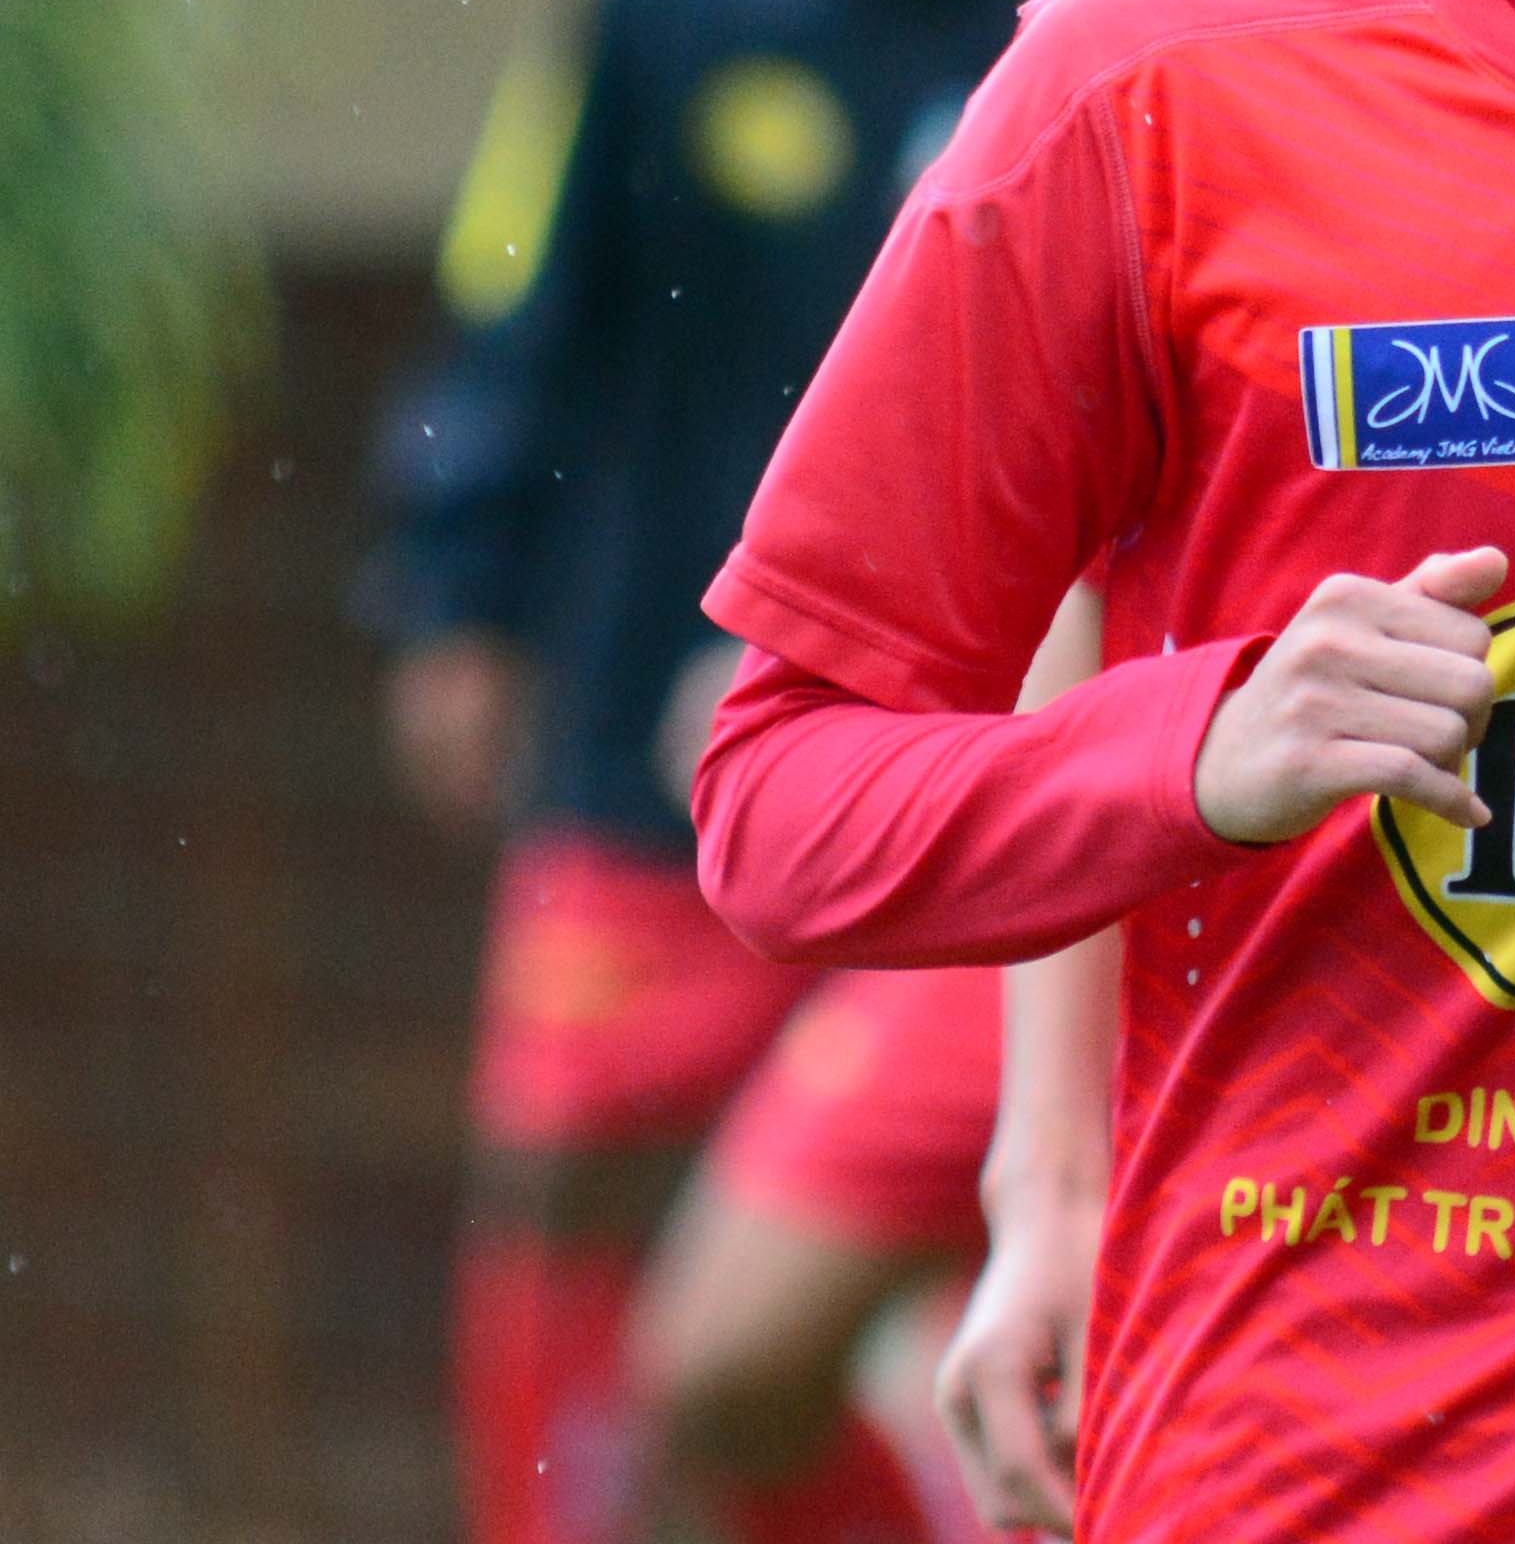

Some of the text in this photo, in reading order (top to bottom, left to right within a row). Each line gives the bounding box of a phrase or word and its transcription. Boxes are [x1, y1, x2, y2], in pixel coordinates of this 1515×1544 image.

[1361, 440, 1432, 464] Academy
[1436, 437, 1476, 458] JMG
[1219, 1173, 1407, 1248] PHÁT
